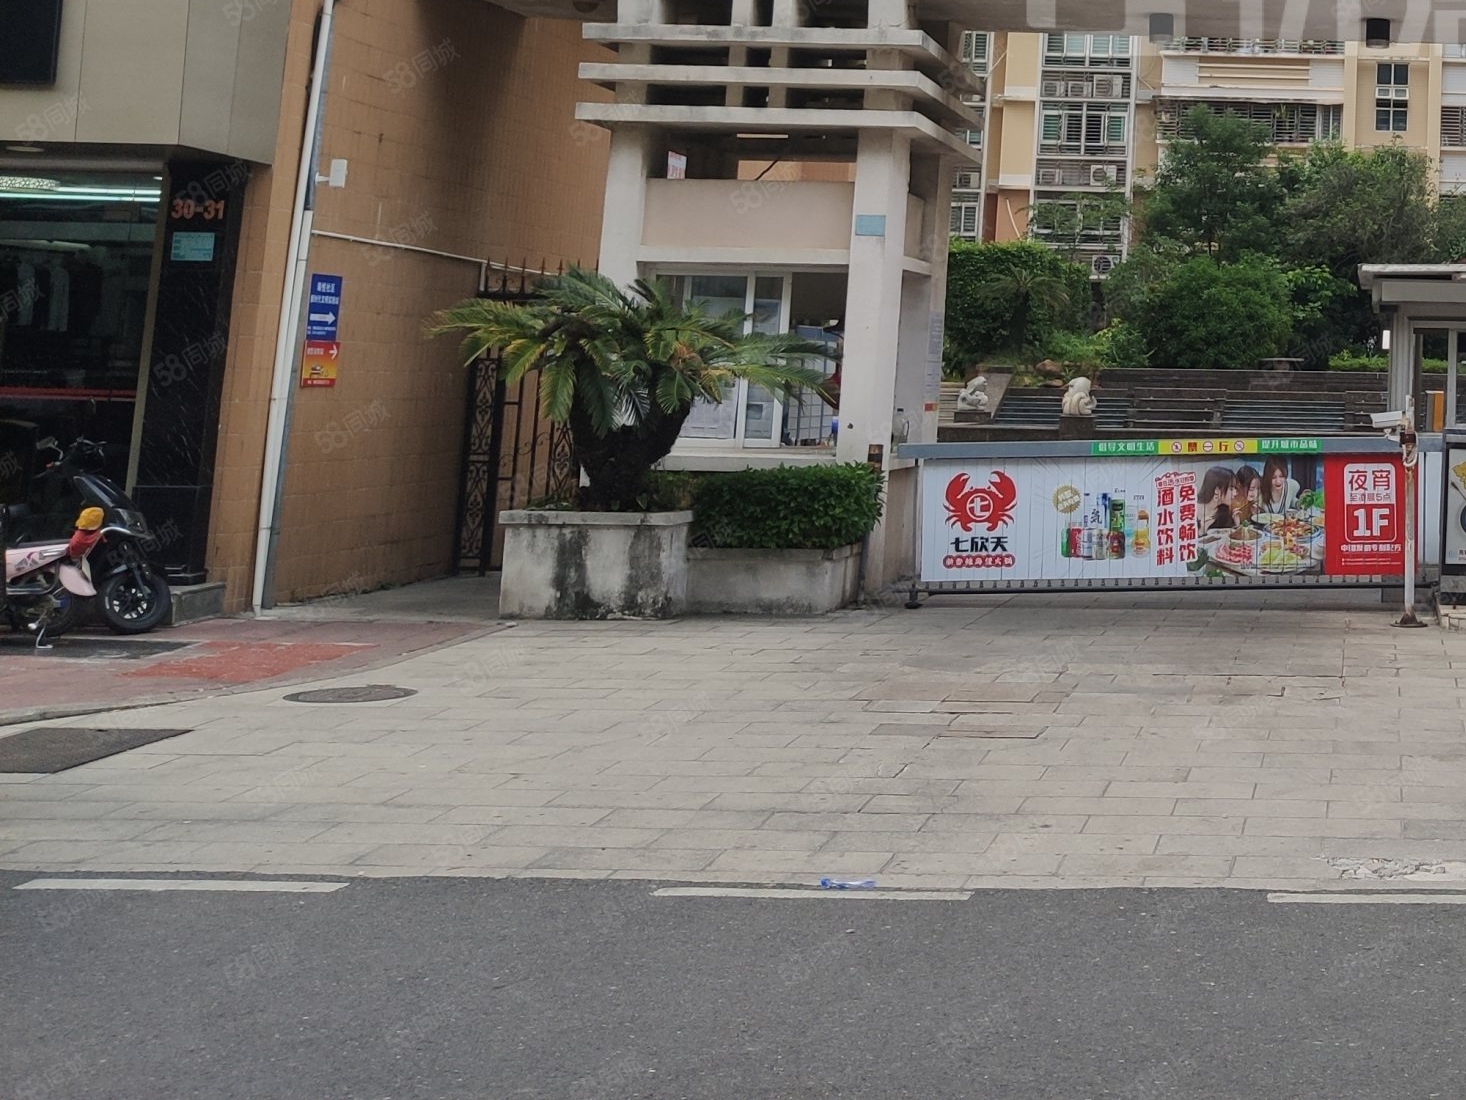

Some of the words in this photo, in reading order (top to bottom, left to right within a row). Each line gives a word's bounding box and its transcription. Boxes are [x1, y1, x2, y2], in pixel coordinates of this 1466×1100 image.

[171, 199, 225, 220] 30-31
[1348, 469, 1391, 491] 夜宵
[1349, 492, 1392, 502] 至凌晨5点
[1156, 487, 1174, 566] 酒水饮料
[1178, 485, 1197, 562] 免费畅饮
[1353, 508, 1390, 537] 1F
[950, 536, 1009, 554] 七欣天
